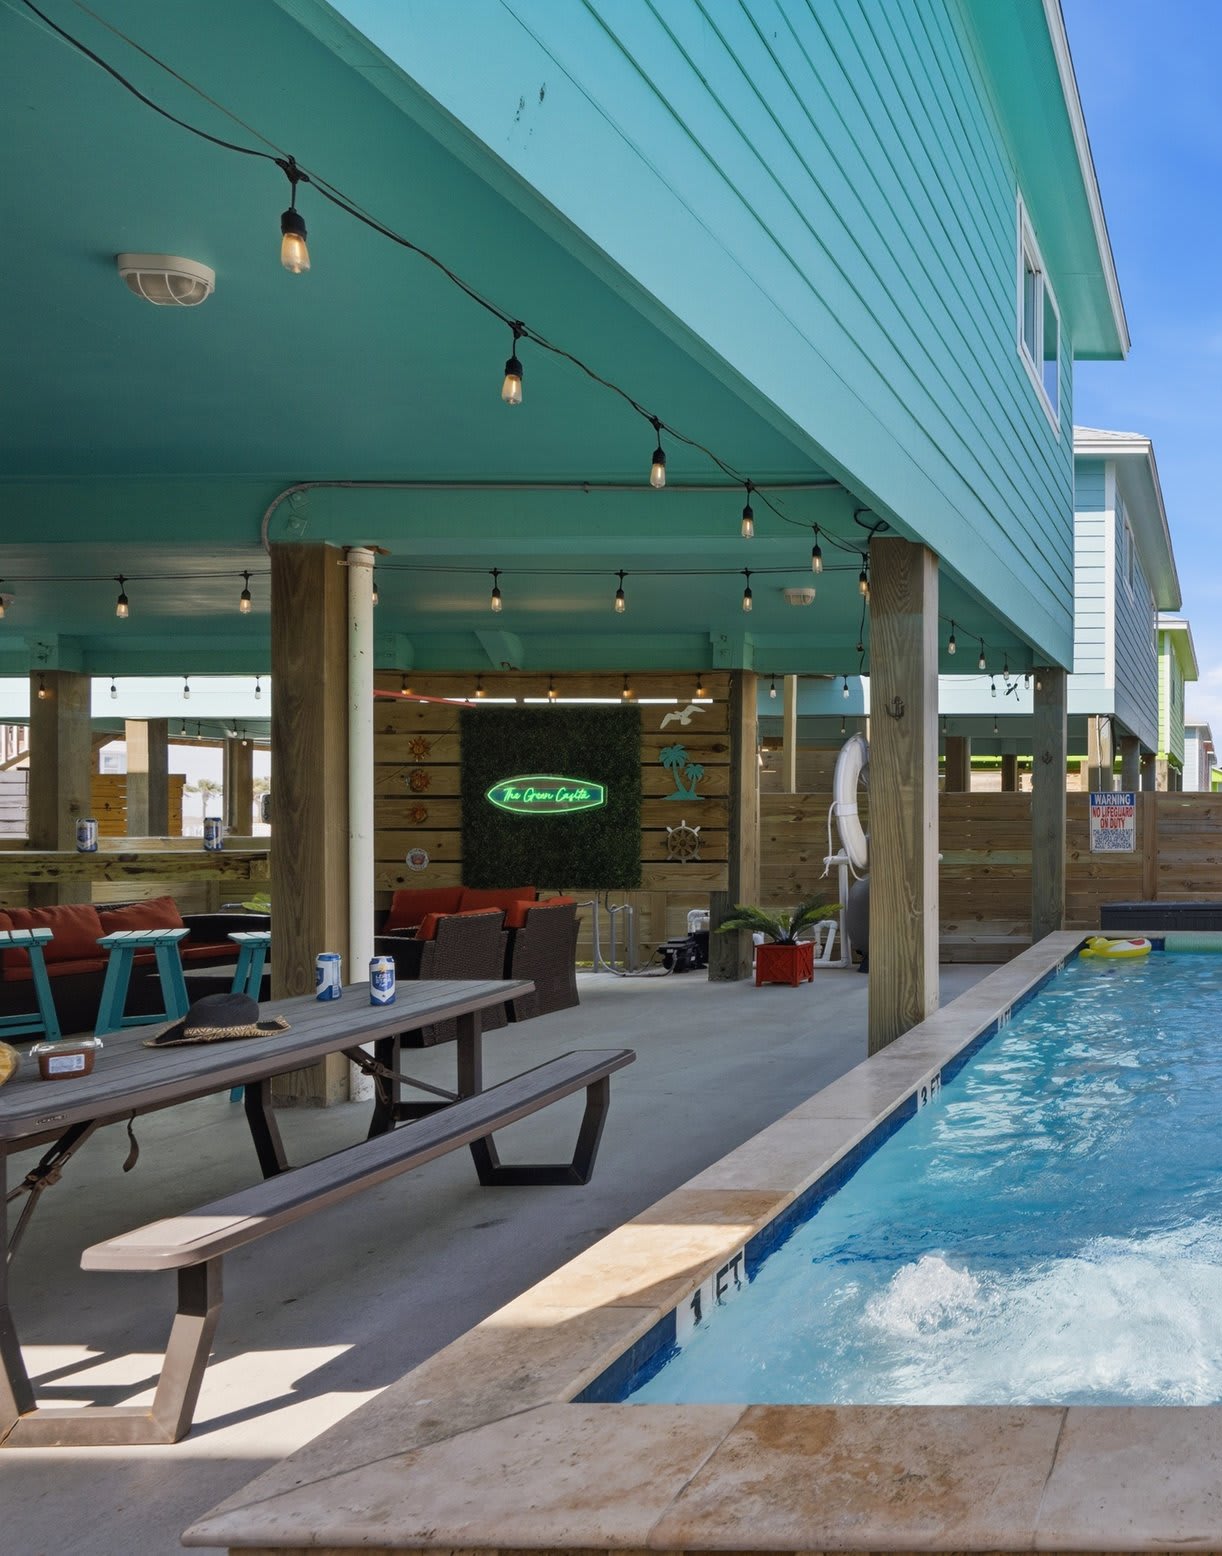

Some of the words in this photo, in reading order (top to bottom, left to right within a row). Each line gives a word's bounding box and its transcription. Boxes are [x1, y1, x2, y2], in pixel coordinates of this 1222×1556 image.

[503, 787, 522, 802] The
[523, 787, 554, 803] Green
[1094, 794, 1131, 805] WARNING
[1092, 806, 1100, 818] NO
[1102, 806, 1134, 818] LIFEGUARD
[1100, 818, 1108, 828] ON
[1110, 818, 1126, 828] DUTY
[716, 1251, 743, 1304] FT
